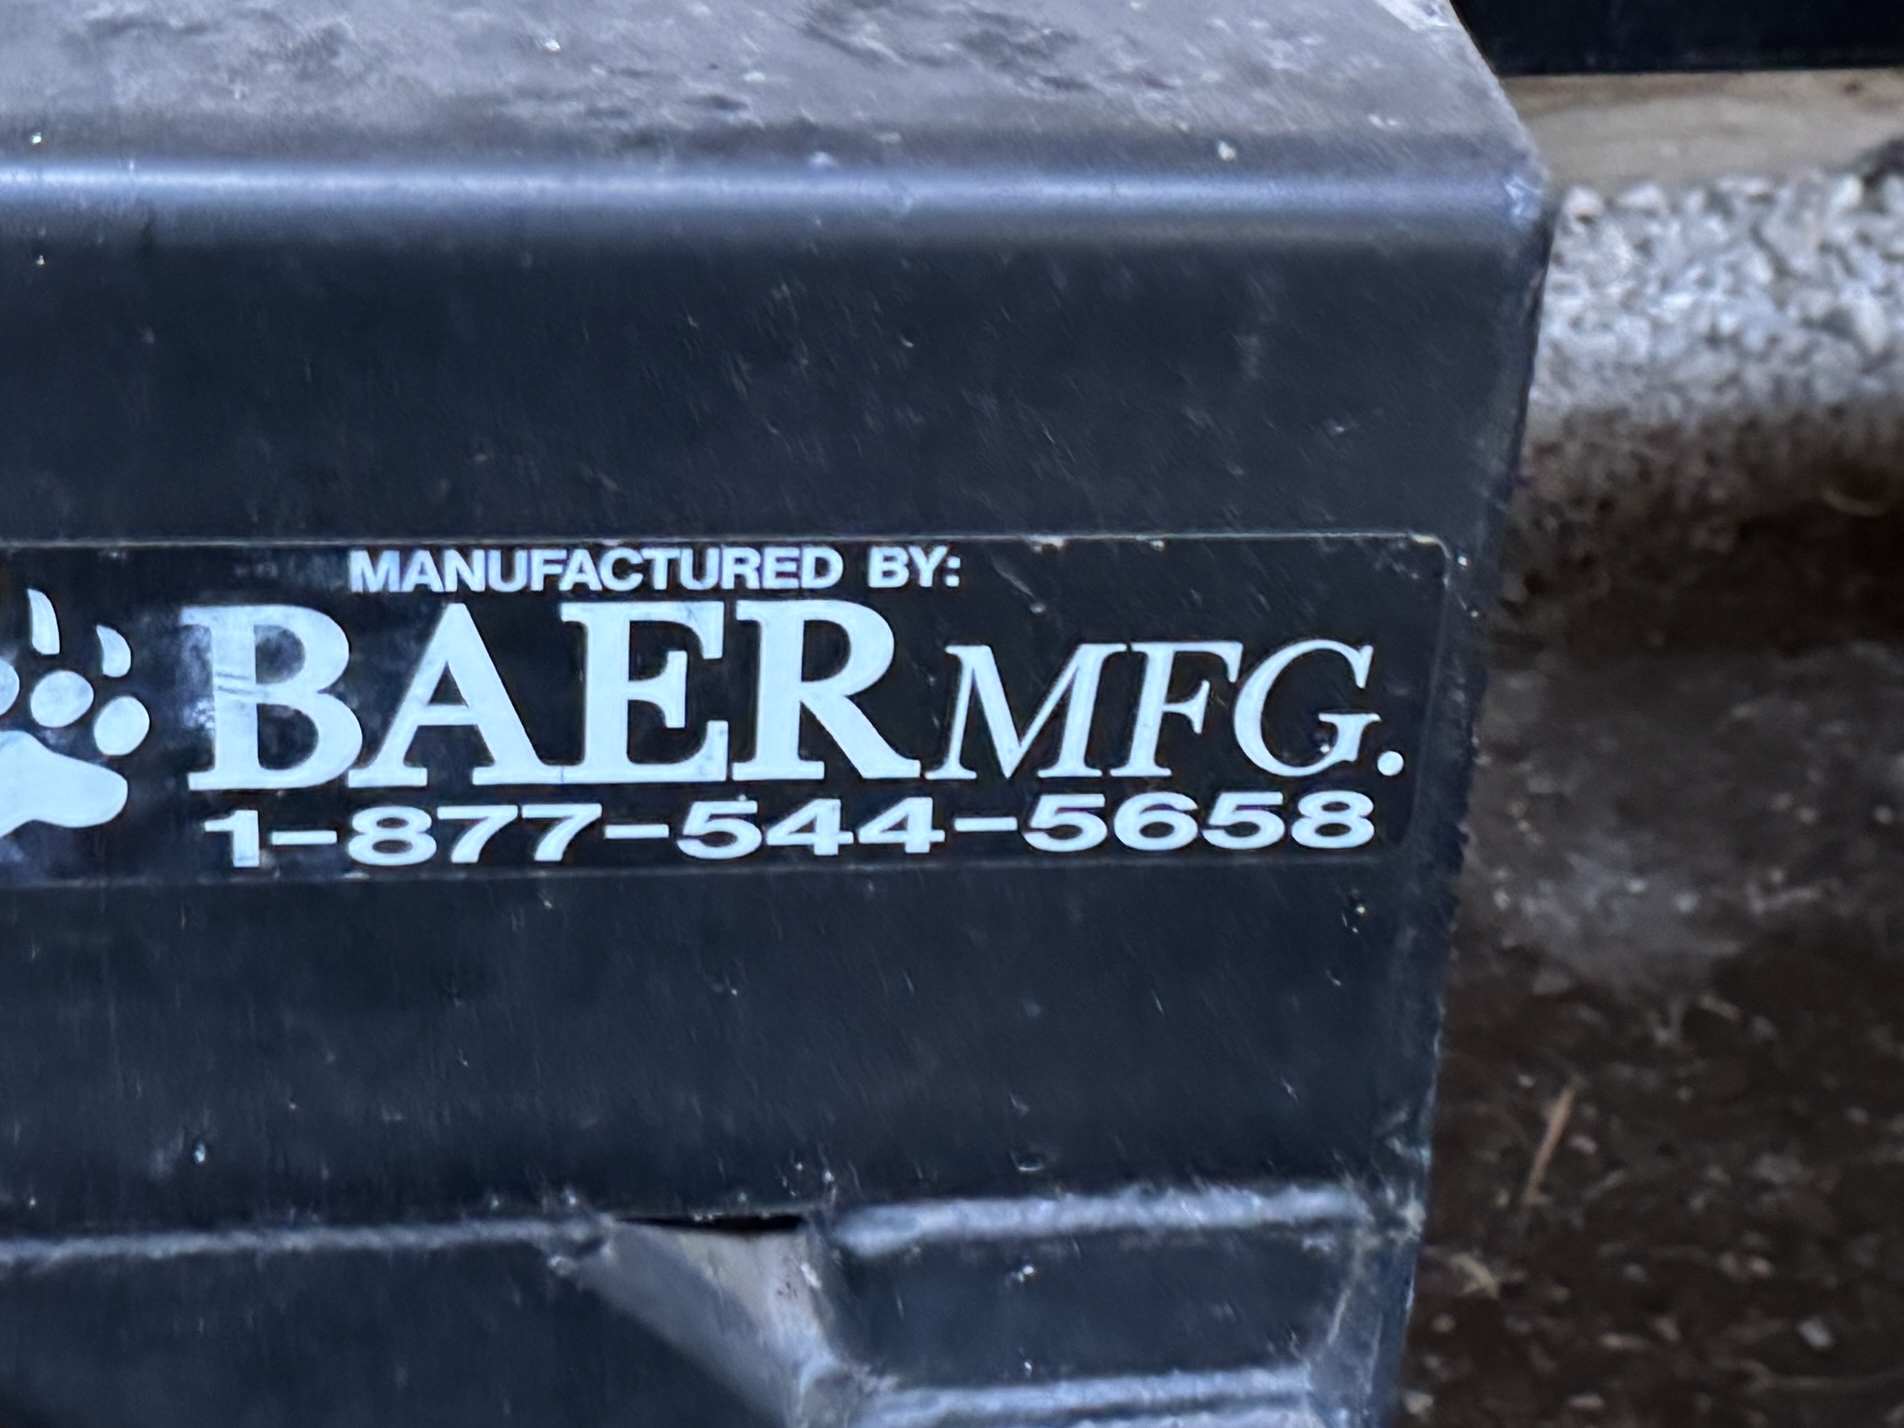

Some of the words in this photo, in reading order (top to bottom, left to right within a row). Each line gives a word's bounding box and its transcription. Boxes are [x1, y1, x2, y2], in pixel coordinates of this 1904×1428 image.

[348, 545, 844, 593] MANUFACTURED
[868, 544, 962, 589] BY:
[181, 598, 921, 791] BAER
[925, 638, 1405, 780] MFG.
[203, 791, 1376, 868] 1-877-544-5658
